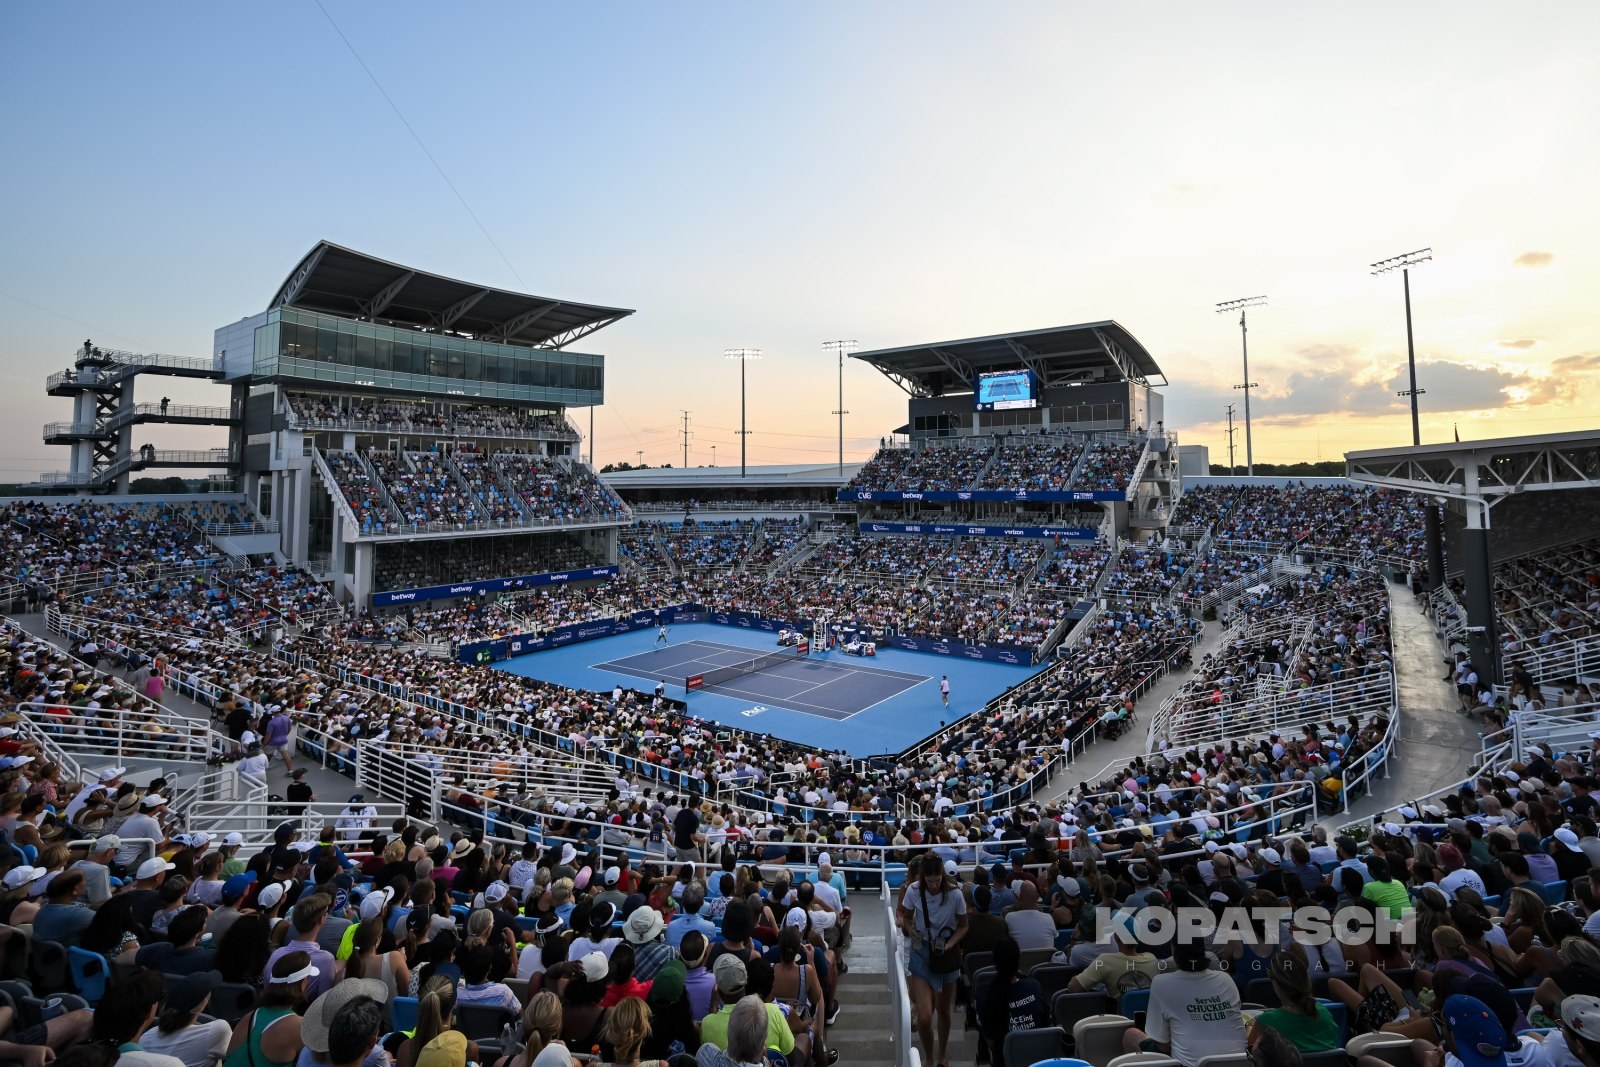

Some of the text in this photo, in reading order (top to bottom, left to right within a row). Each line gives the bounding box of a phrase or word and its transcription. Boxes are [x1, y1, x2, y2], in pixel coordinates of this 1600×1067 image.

[902, 492, 923, 500] betway
[450, 585, 473, 593] betway
[391, 593, 416, 601] betway
[1195, 995, 1220, 1005] Served
[1187, 1001, 1232, 1013] CHUCKERS
[1203, 1011, 1226, 1022] CLUB
